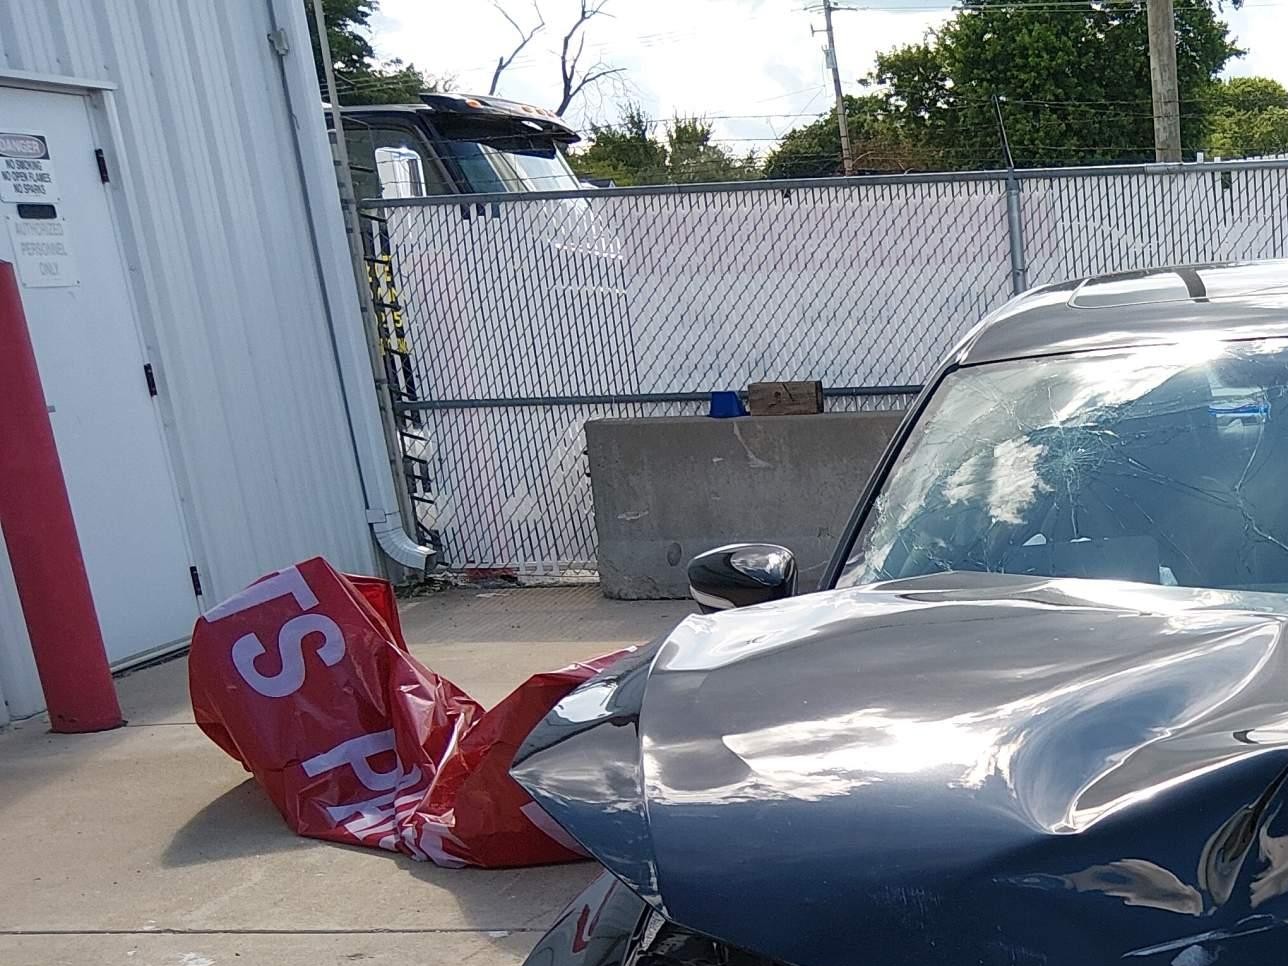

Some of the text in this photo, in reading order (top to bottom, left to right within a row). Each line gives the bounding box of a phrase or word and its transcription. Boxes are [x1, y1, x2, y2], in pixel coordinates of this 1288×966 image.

[0, 137, 41, 153] DANGER
[5, 159, 43, 171] NO SMOKING
[1, 170, 52, 183] NO OPEN FLAMES
[13, 183, 47, 195] NO SPARKS
[20, 242, 68, 256] PERSONNEL
